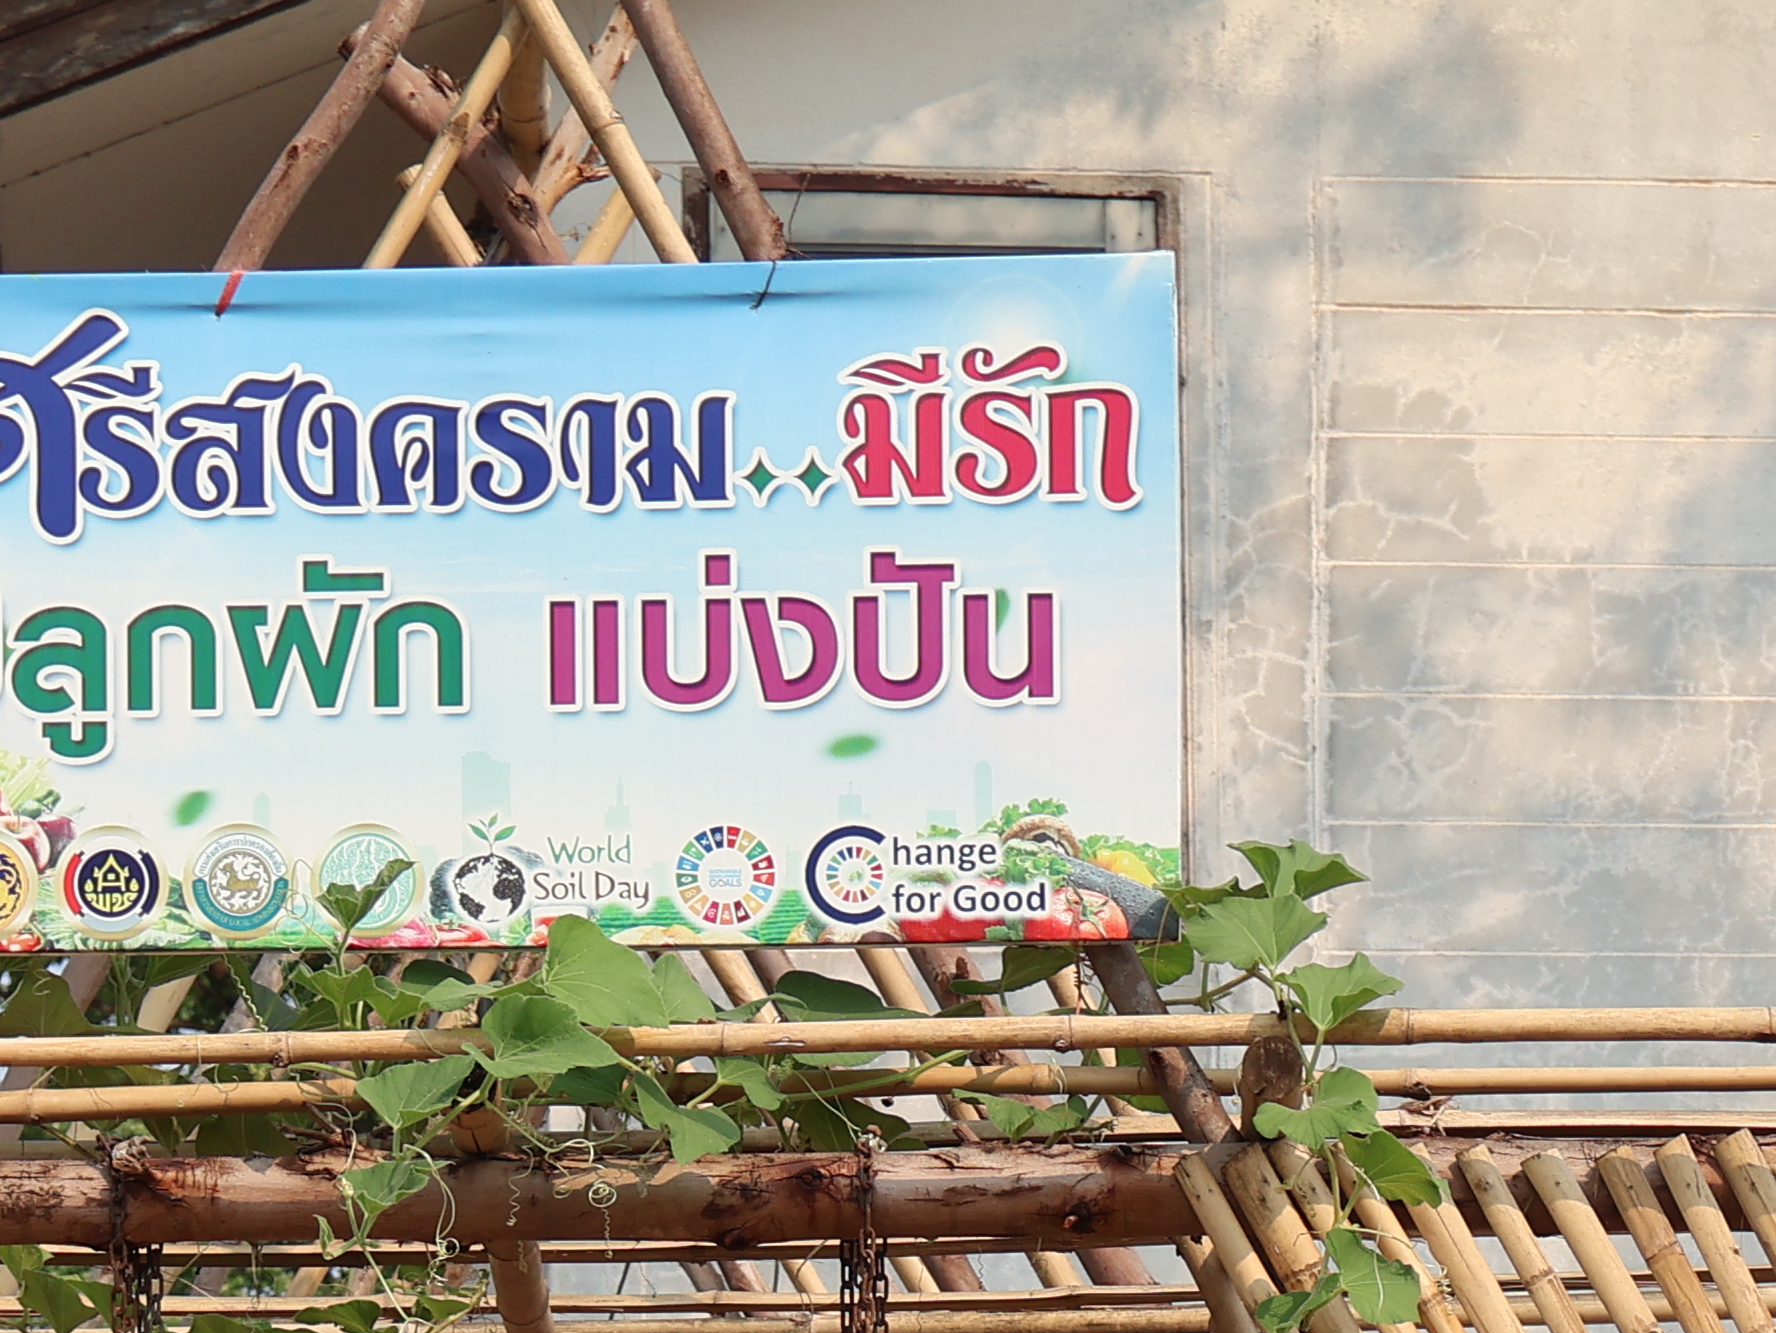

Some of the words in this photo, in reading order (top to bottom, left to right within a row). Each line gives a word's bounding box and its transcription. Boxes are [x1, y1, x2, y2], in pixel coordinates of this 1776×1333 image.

[840, 346, 1141, 507] มีรัก
[548, 551, 1055, 704] แบ่งปัน
[546, 834, 631, 865] World
[532, 870, 588, 900] Soil
[594, 870, 650, 910] Day
[891, 883, 942, 913] for
[952, 882, 1047, 913] Good
